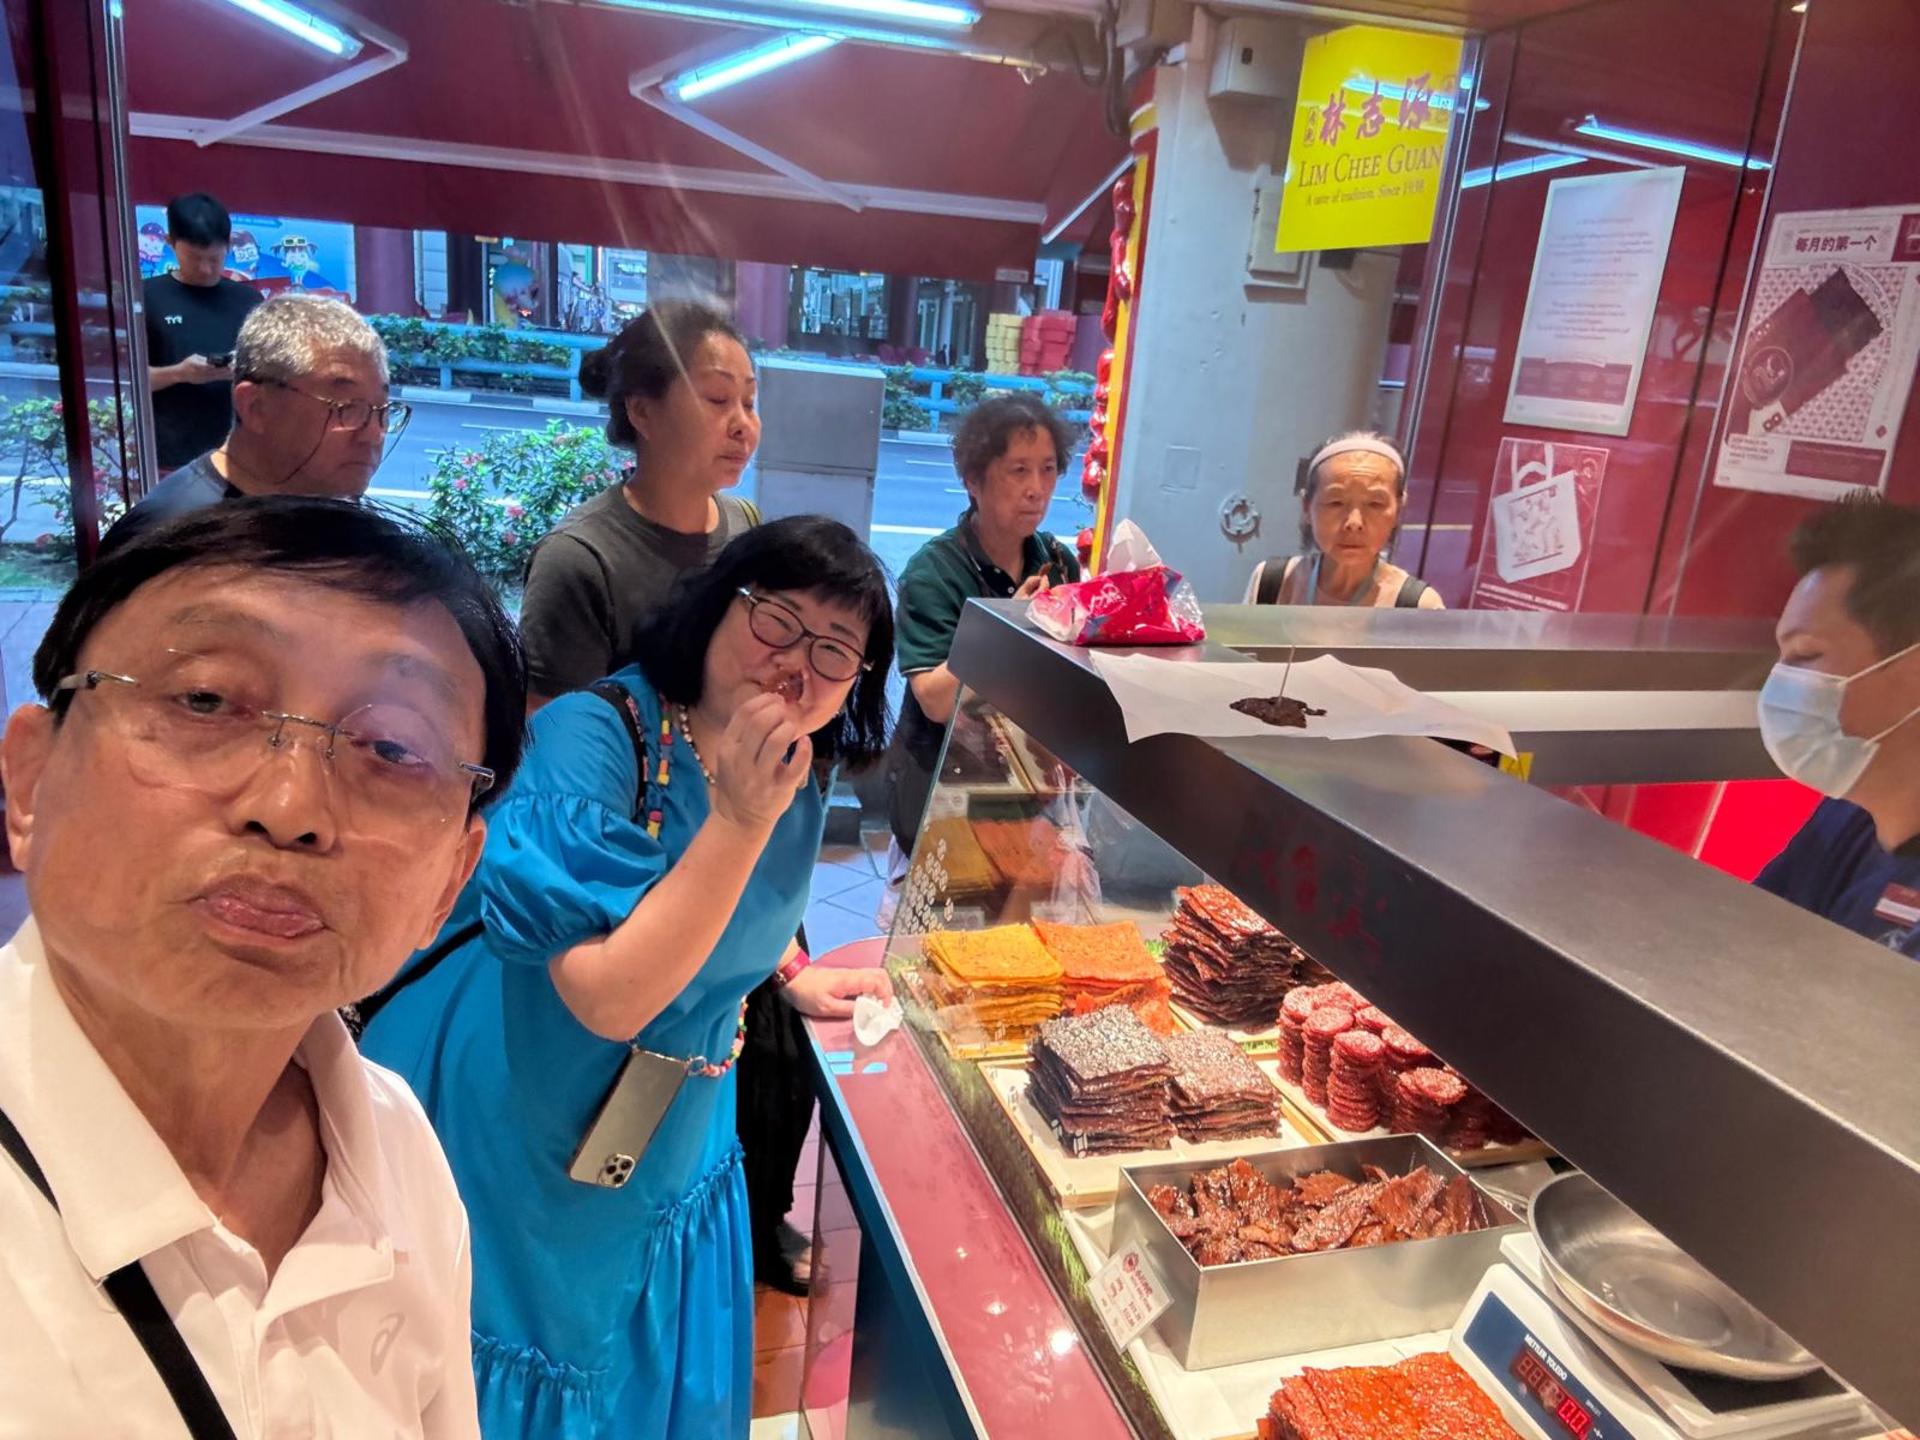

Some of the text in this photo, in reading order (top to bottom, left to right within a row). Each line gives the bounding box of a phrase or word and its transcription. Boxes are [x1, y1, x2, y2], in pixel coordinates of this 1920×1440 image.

[1299, 143, 1441, 187] LIM CHEE GUAN
[1796, 234, 1877, 253] 每月的第一个
[164, 315, 183, 324] TYR
[1524, 1333, 1568, 1380] METTLER TOLEDO
